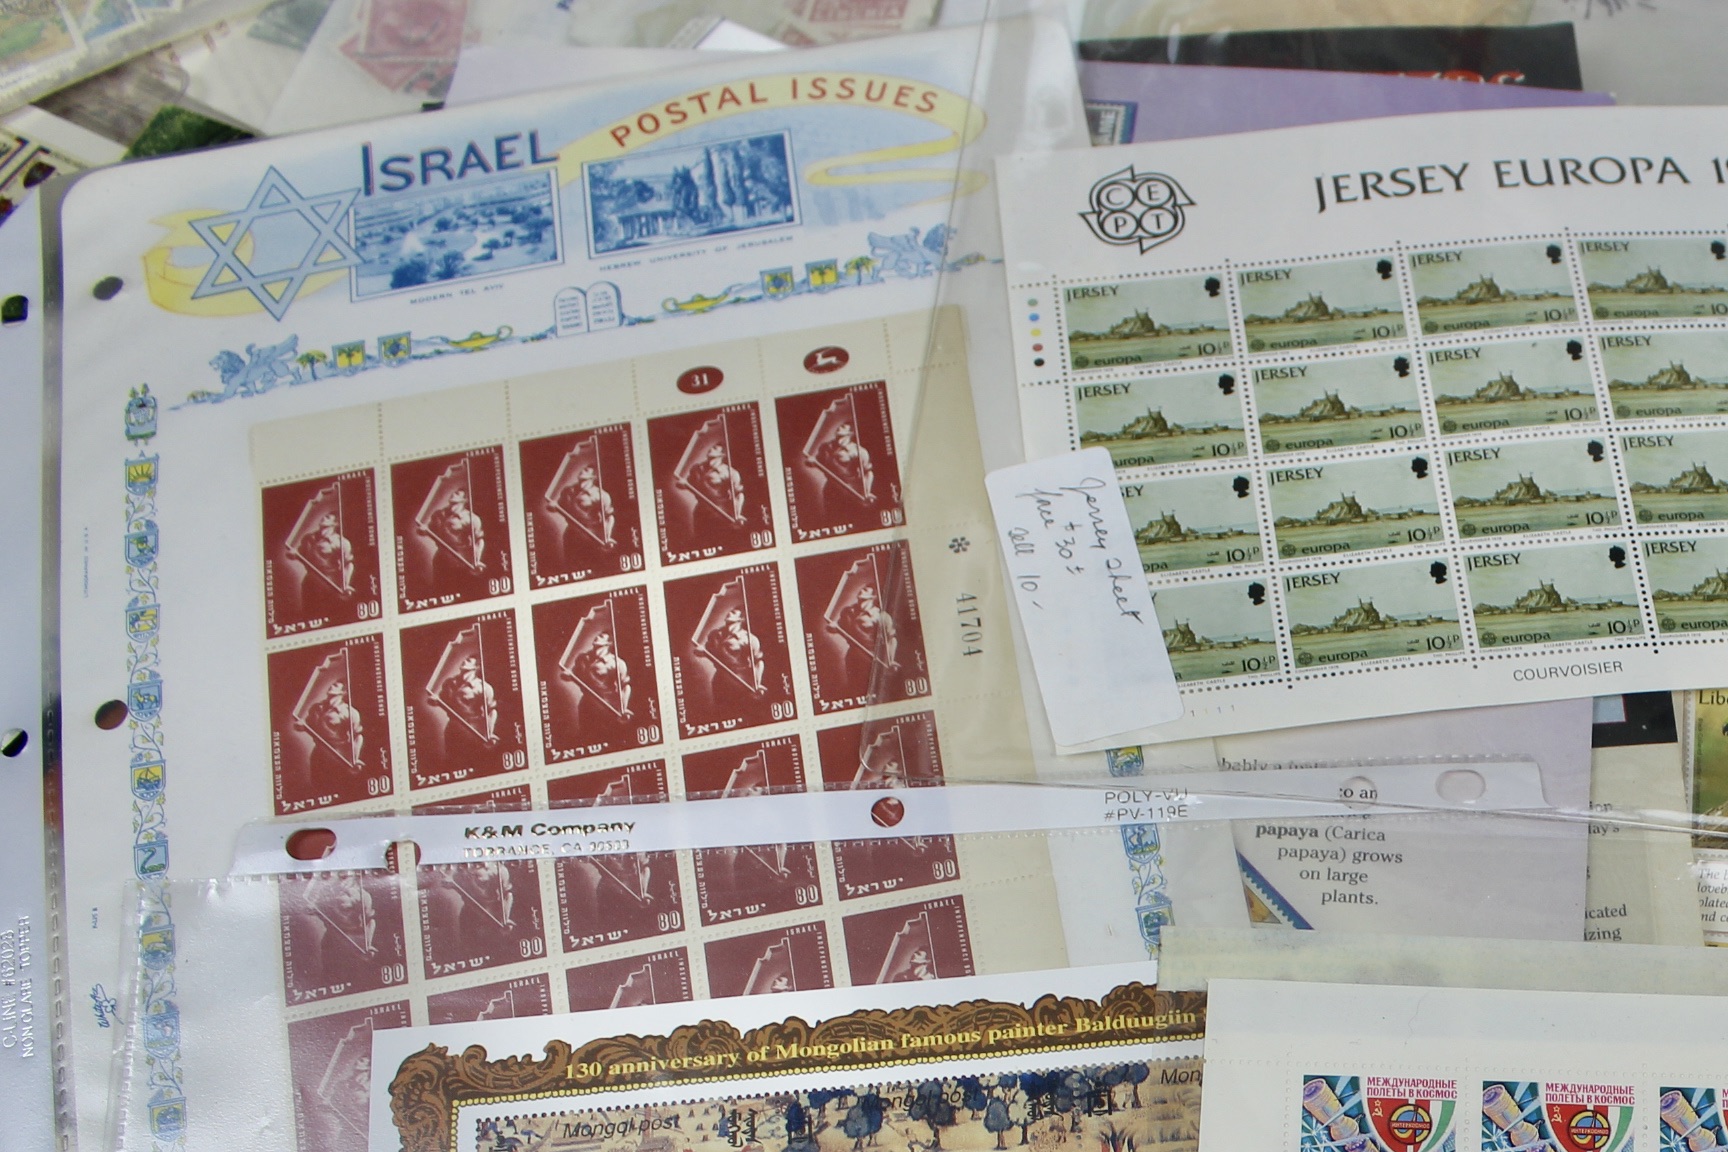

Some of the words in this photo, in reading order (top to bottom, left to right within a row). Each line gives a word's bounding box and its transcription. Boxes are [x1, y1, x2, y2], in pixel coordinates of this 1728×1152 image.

[610, 82, 769, 147] POSTAL
[791, 77, 939, 114] ISSUES
[361, 128, 561, 197] ISRAEL
[1315, 162, 1470, 214] JERSEY
[1493, 155, 1692, 190] EUROPA
[1443, 318, 1490, 333] europa
[691, 373, 710, 387] 31
[750, 530, 774, 548] 80
[956, 591, 984, 658] 41704
[1318, 648, 1369, 664] europa
[1512, 660, 1625, 683] COURVOISIER
[771, 700, 795, 720] 80
[464, 824, 524, 841] K&M
[530, 820, 637, 838] Company
[1255, 823, 1320, 839] papaya
[1325, 825, 1386, 843] (Carica
[1278, 846, 1347, 863] papaya)
[1352, 850, 1404, 864] grows
[1300, 868, 1320, 880] on
[1327, 867, 1369, 886] large
[1321, 889, 1379, 906] plants.
[565, 1061, 603, 1080] 130
[608, 1049, 741, 1078] anniversary
[746, 1042, 772, 1063] of
[775, 1036, 895, 1062] Mongolian
[900, 1029, 982, 1049] famous
[988, 1021, 1070, 1044] painter
[1074, 1009, 1198, 1035] Balduugiin
[1366, 1076, 1458, 1089] МЕЖДУНАРОДНЫЕ
[1366, 1087, 1406, 1098] ПОЛЕТЫ
[1415, 1088, 1458, 1099] КОСМОС
[638, 1113, 680, 1134] post
